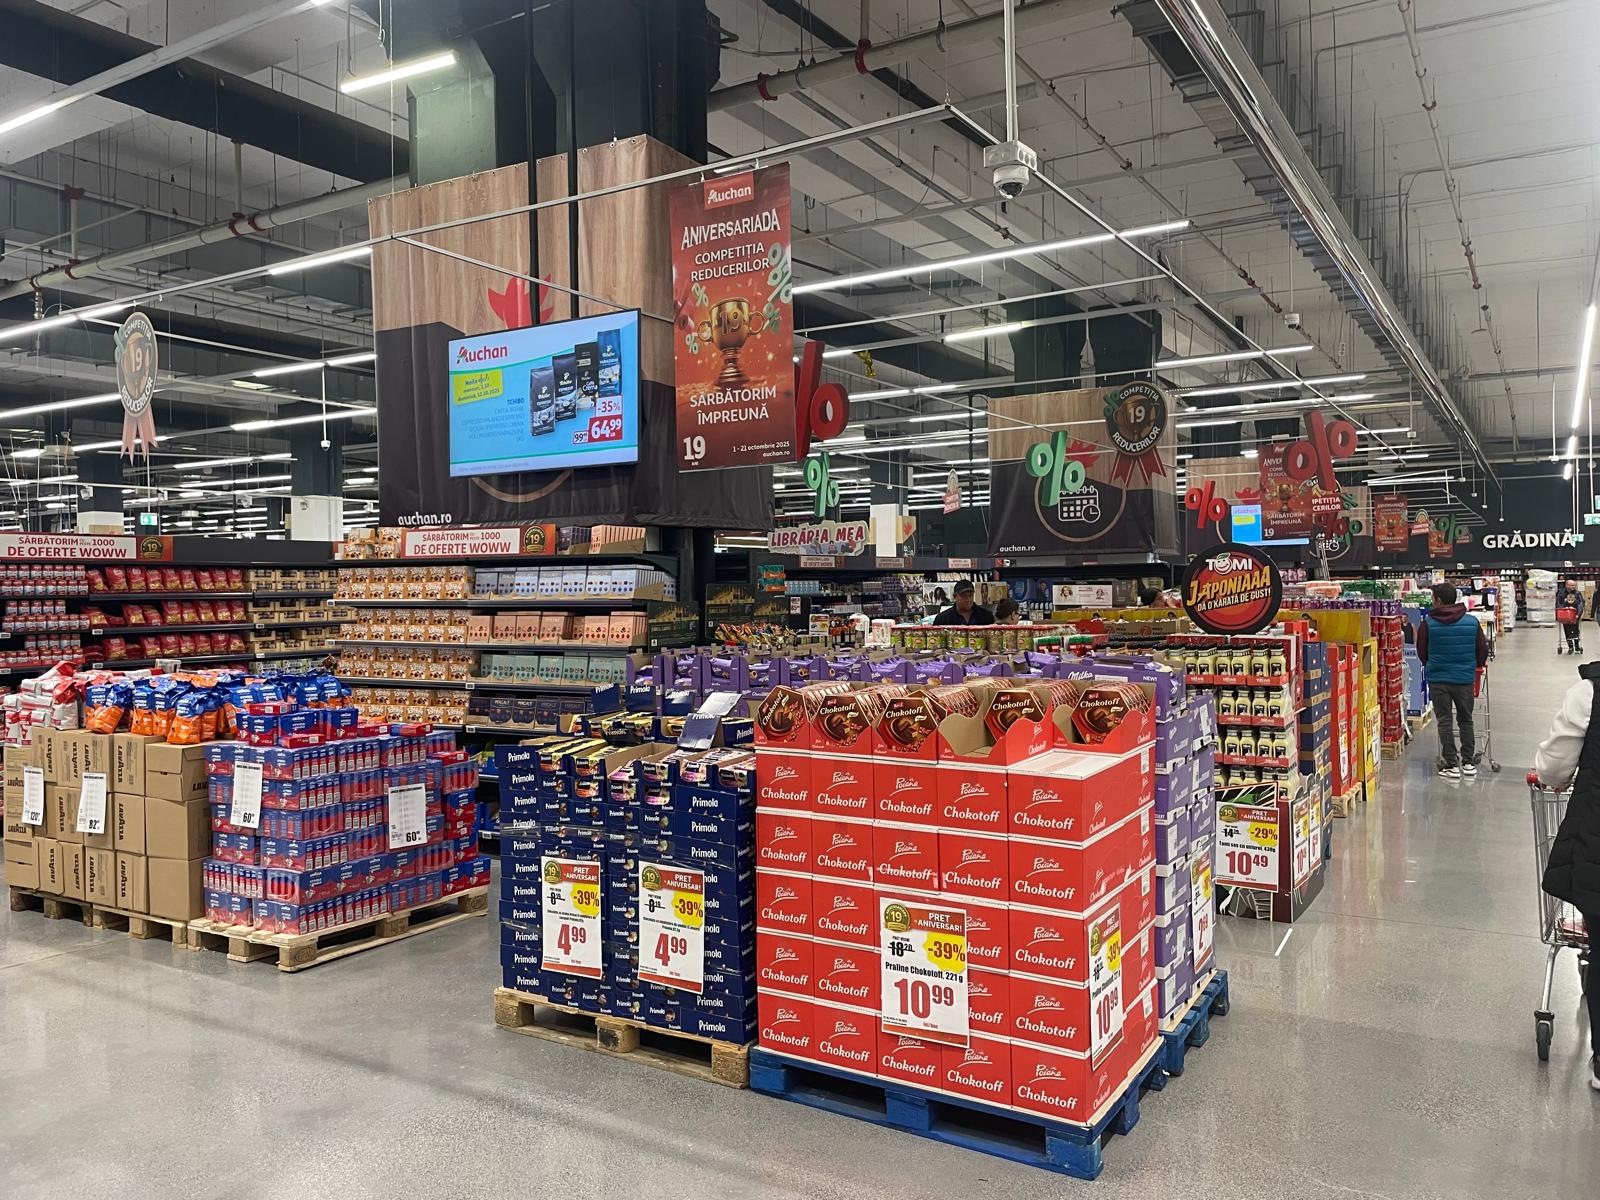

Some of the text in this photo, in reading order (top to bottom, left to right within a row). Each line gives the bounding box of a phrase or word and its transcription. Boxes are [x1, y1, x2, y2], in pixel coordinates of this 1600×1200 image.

[707, 185, 751, 204] Auchan
[681, 208, 780, 250] ANIVERSARIADA
[695, 242, 764, 266] COMPETIȚIA
[691, 258, 769, 282] REDUCERILOR
[132, 347, 142, 373] 19
[456, 345, 508, 365] Auchan
[121, 376, 154, 412] REDUCERILOR
[690, 385, 776, 408] SĂRBĂTORIM
[1120, 385, 1160, 402] COMPETIȚIA
[697, 403, 768, 425] ÎMPREUNĂ
[1128, 406, 1146, 424] 19
[1112, 426, 1161, 452] REDUCERILOR
[683, 435, 706, 460] 19
[398, 511, 452, 526] auchan.ro
[480, 532, 500, 540] 1000
[530, 534, 540, 544] 19
[771, 526, 864, 548] LIBRĂRIA MEA
[1264, 528, 1274, 537] 19
[1482, 528, 1574, 550] GRĂDINĂ
[18, 536, 78, 546] SĂRBĂTORIM
[147, 543, 158, 552] 19
[414, 542, 511, 555] DE OFERTE WOWW
[8, 546, 127, 558] DE OFERTE WOWW
[1206, 554, 1253, 574] TOMI
[1186, 566, 1271, 606] JAPONIAAA
[1208, 601, 1212, 610] O
[1240, 593, 1250, 602] DE
[630, 685, 650, 694] Primola
[762, 690, 786, 726] Chokotoff
[820, 702, 856, 715] Chokotoff
[992, 698, 1031, 711] Chokotoff
[1080, 698, 1120, 709] Chokotoff
[886, 706, 924, 719] Chokotoff
[508, 752, 530, 762] Primola
[512, 773, 535, 784] Primola
[514, 796, 537, 806] Primola
[692, 796, 718, 807] Primola
[761, 787, 808, 801] Chokotoff
[817, 793, 867, 808] Chokotoff
[879, 800, 932, 815] Chokotoff
[944, 806, 1000, 822] Chokotoff
[692, 821, 718, 832] Primola
[1014, 813, 1074, 830] Chokotoff
[513, 841, 536, 850] Primola
[691, 847, 718, 858] Primola
[761, 848, 807, 862] Chokotoff
[817, 854, 867, 870] Chokotoff
[515, 864, 538, 873] Primola
[549, 866, 556, 876] 19
[573, 866, 590, 874] PRET
[879, 863, 932, 880] Chokotoff
[647, 873, 655, 882] 19
[674, 875, 692, 883] PRET
[945, 871, 1001, 889] Chokotoff
[514, 886, 537, 895] Primola
[1014, 880, 1075, 900] Chokotoff
[513, 909, 537, 919] Primola
[761, 908, 807, 924] Chokotoff
[891, 911, 902, 922] 19
[928, 912, 950, 922] PRET
[818, 918, 868, 935] Chokotoff
[918, 920, 962, 932] ANIVERSAR!
[515, 932, 538, 941] Primola
[515, 954, 538, 964] Primola
[1015, 949, 1076, 970] Chokotoff
[761, 968, 808, 985] Chokotoff
[886, 962, 909, 973] Praline
[946, 972, 958, 982] 221
[517, 976, 539, 986] Primola
[818, 979, 869, 998] Chokotoff
[697, 996, 724, 1008] Primola
[699, 1020, 726, 1032] Primola
[1016, 1017, 1076, 1039] Chokotoff
[762, 1028, 809, 1047] Chokotoff
[820, 1042, 870, 1061] Chokotoff
[882, 1056, 936, 1076] Chokotoff
[947, 1070, 1004, 1092] Chokotoff
[1017, 1086, 1077, 1110] Chokotoff
